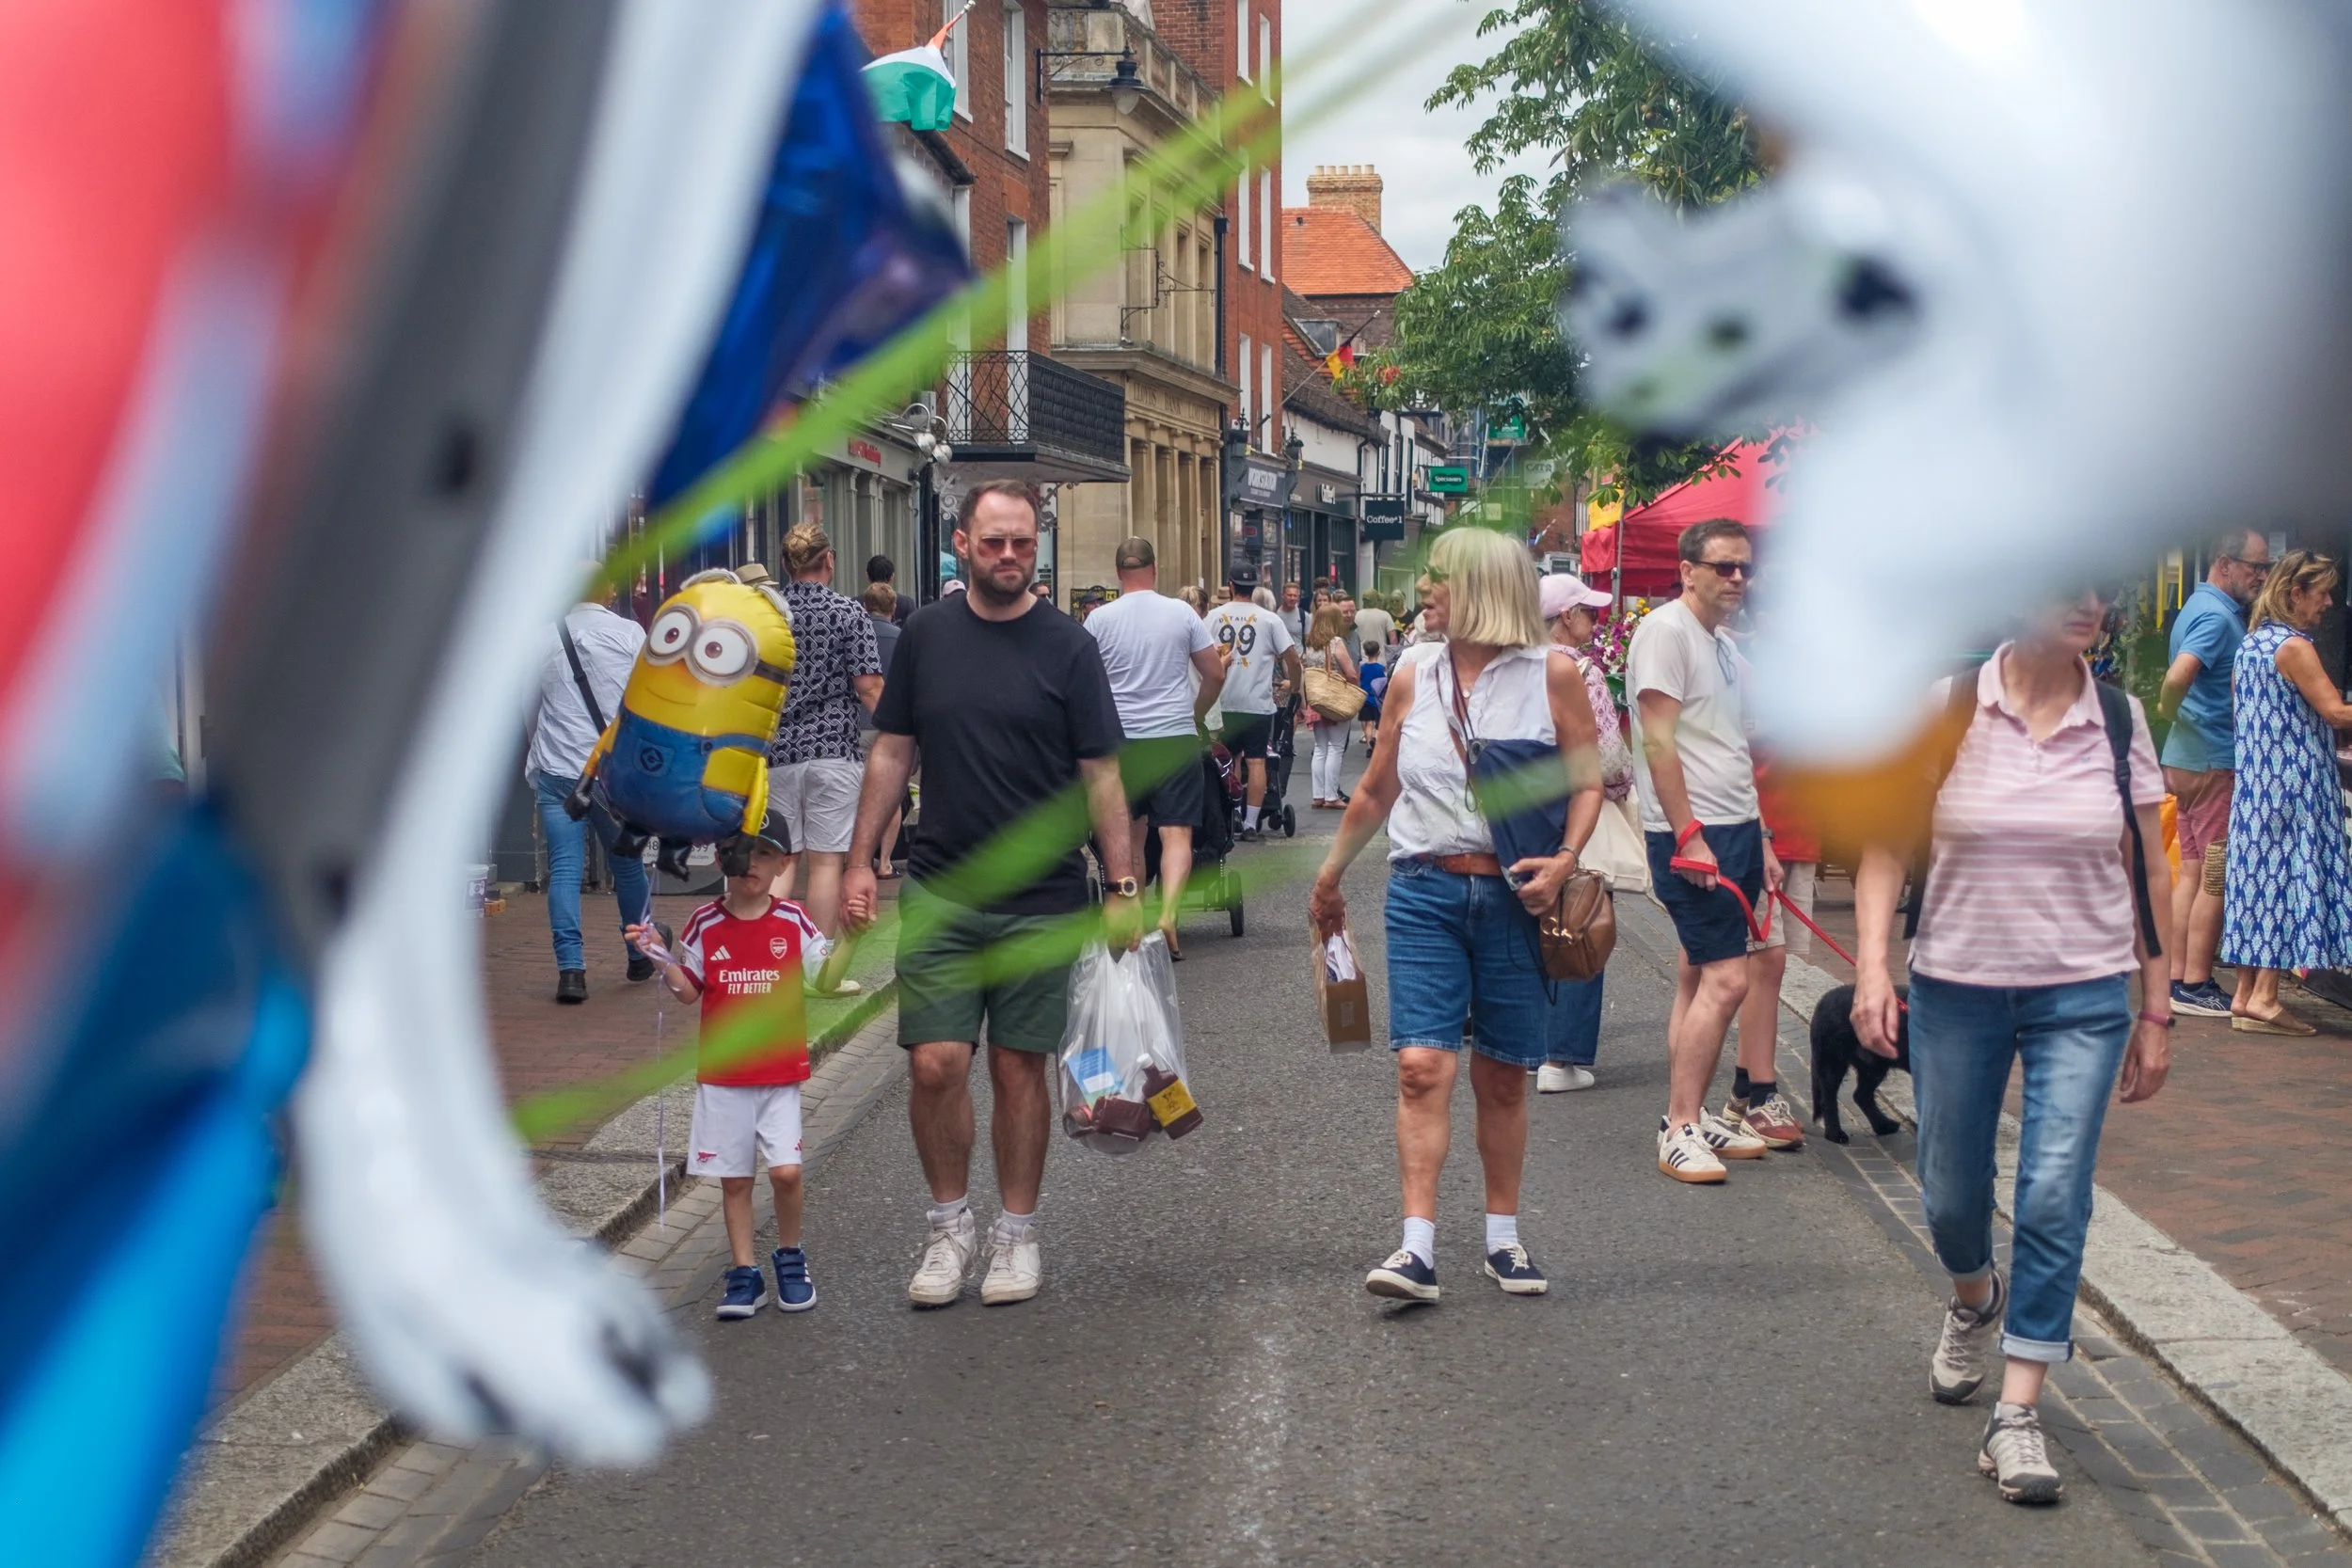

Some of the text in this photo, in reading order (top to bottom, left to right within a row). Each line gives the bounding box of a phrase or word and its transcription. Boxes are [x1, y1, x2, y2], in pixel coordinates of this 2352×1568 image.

[1218, 624, 1256, 656] 99
[719, 968, 780, 983] Emirates
[727, 982, 771, 994] FLY BETTER
